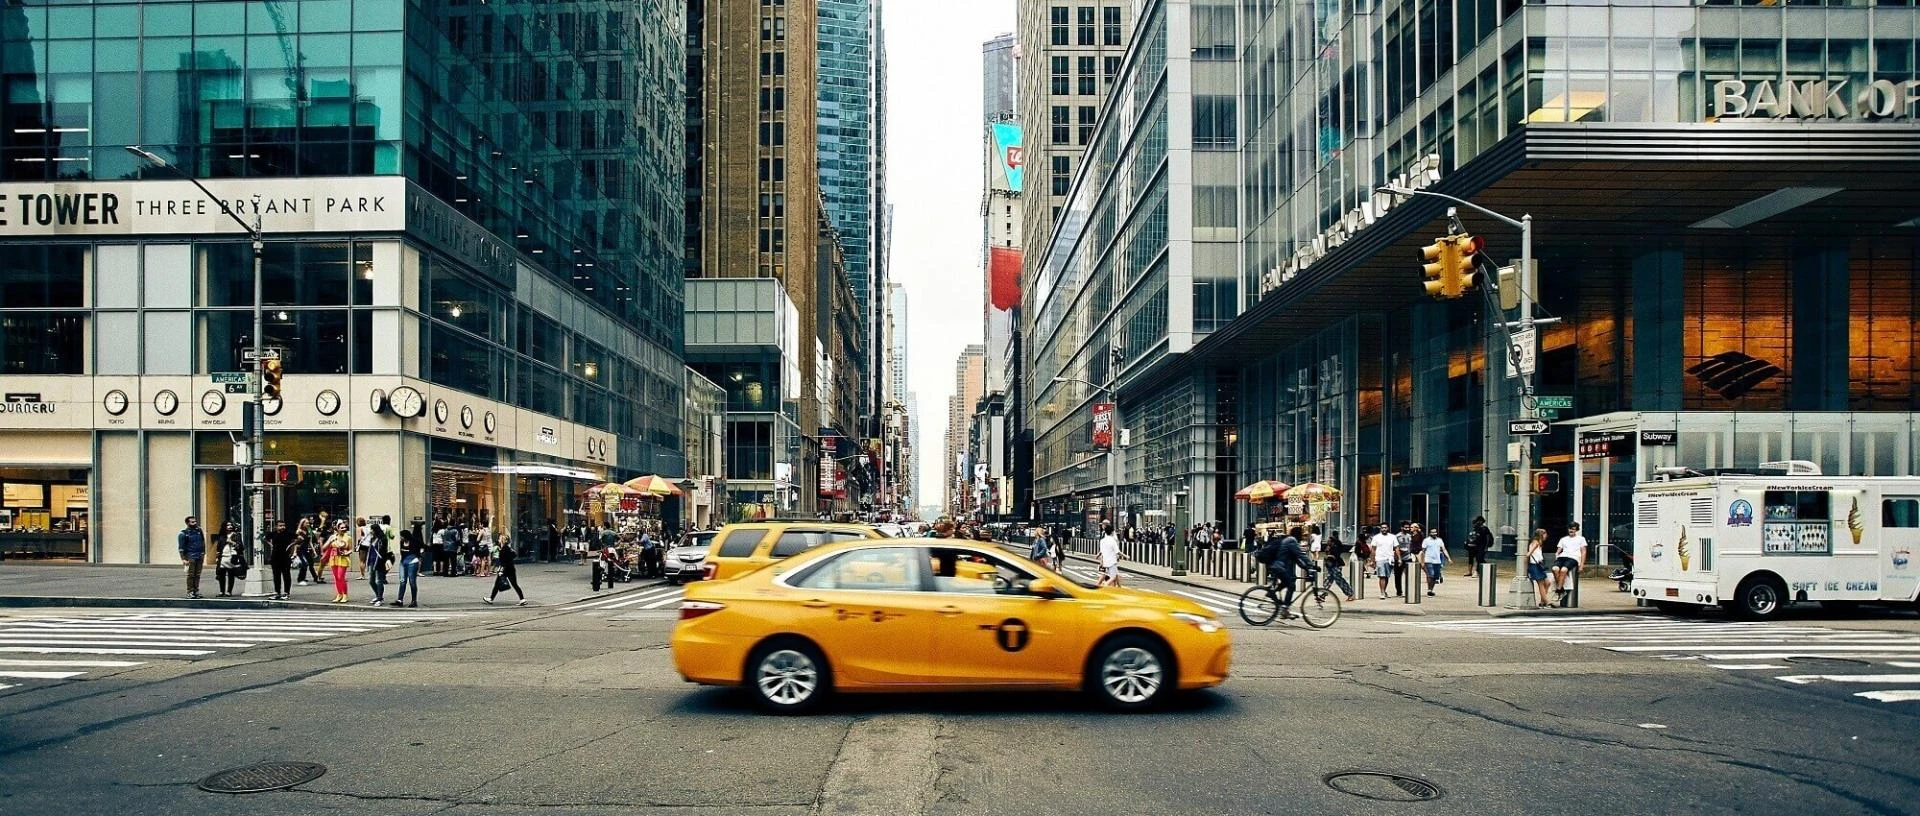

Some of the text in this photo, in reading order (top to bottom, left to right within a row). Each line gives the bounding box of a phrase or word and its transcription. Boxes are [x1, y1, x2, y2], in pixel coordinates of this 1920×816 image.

[1715, 79, 1920, 118] BANK OF
[18, 193, 119, 225] TOWER
[136, 196, 385, 215] THREE BRYANT PARK
[1541, 409, 1547, 417] 6
[1642, 432, 1672, 441] Subway
[1792, 581, 1878, 591] SOFT ICE CREAM
